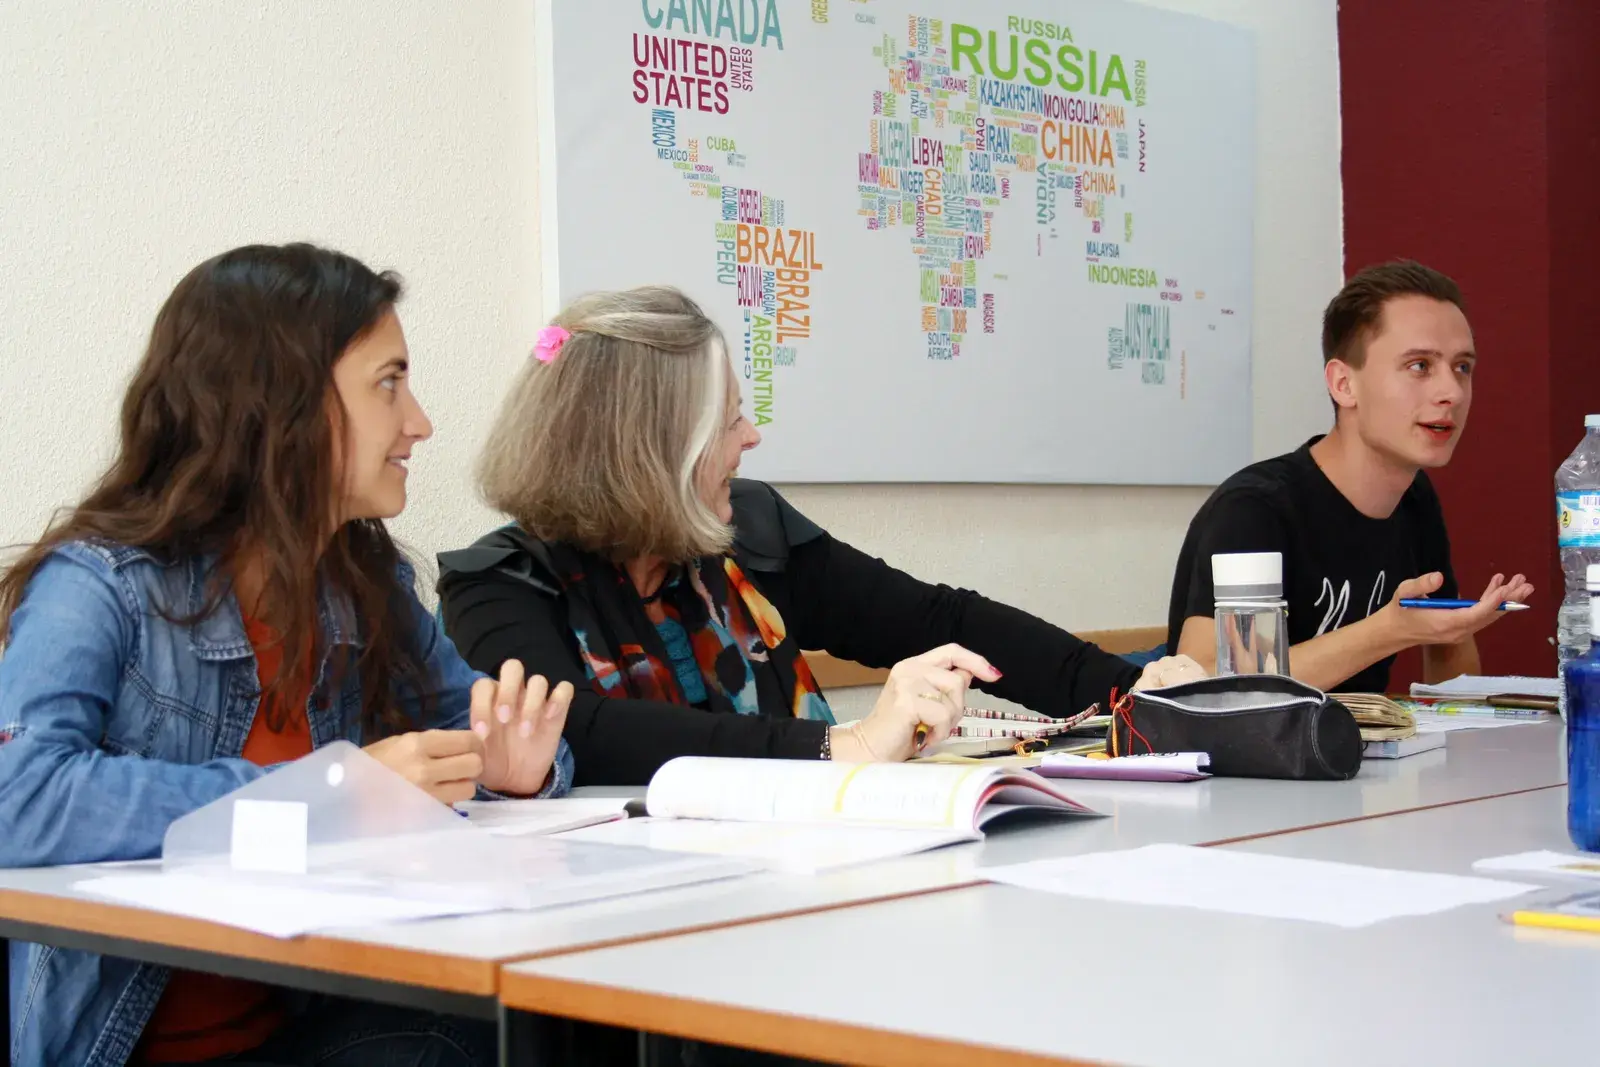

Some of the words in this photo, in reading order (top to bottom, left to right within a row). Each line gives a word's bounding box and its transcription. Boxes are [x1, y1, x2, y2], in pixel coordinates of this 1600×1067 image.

[642, 0, 783, 50] CANADA
[918, 16, 928, 57] SWEDEN
[1007, 15, 1073, 43] RUSSIA
[633, 33, 727, 78] UNITED
[730, 46, 742, 89] UNITED
[741, 48, 753, 92] STATES
[951, 23, 1132, 101] RUSSIA
[633, 69, 729, 115] STATES
[941, 76, 968, 93] UKRAINE
[980, 78, 1043, 114] KAZAKHSTAN
[1134, 59, 1146, 107] RUSSIA
[883, 92, 896, 117] SPAIN
[910, 90, 919, 116] ITALY
[947, 110, 976, 127] TURKEY
[1043, 94, 1099, 125] MONGOLIA
[1099, 103, 1125, 129] CHINA
[652, 108, 676, 148] MEXICO
[976, 118, 985, 151] IRAQ
[986, 124, 1010, 154] IRAN
[657, 148, 688, 161] MEXICO
[689, 138, 698, 162] BELIZE
[706, 136, 736, 152] CUBA
[912, 137, 945, 168] LIBYA
[993, 152, 1016, 165] IRAN
[1041, 120, 1115, 168] CHINA
[880, 166, 899, 190] MALI
[969, 152, 990, 173] SAUDI
[900, 170, 924, 195] NIGER
[925, 168, 942, 215] CHAD
[970, 173, 996, 195] ARABIA
[1001, 177, 1010, 199] OMAN
[1037, 162, 1047, 225] INDIA
[1082, 170, 1116, 195] CHINA
[722, 186, 737, 221] COLOMBIA
[916, 194, 924, 239] CAMEROON
[944, 194, 964, 230] SUDAN
[736, 223, 822, 270] BRAZIL
[965, 235, 984, 259] KENYA
[1086, 241, 1120, 259] MALAYSIA
[716, 240, 736, 285] PERU
[1088, 264, 1158, 289] INDONESIA
[737, 265, 762, 308] BOLIVIA
[763, 270, 775, 317] PARAGUAY
[940, 287, 963, 306] ZAMBIA
[776, 267, 811, 344] BRAZIL
[984, 293, 994, 333] MADAGASCAR
[928, 332, 950, 346] SOUTH
[928, 346, 952, 360] AFRICA
[752, 314, 773, 427] ARGENTINA
[1563, 511, 1568, 522] 2
